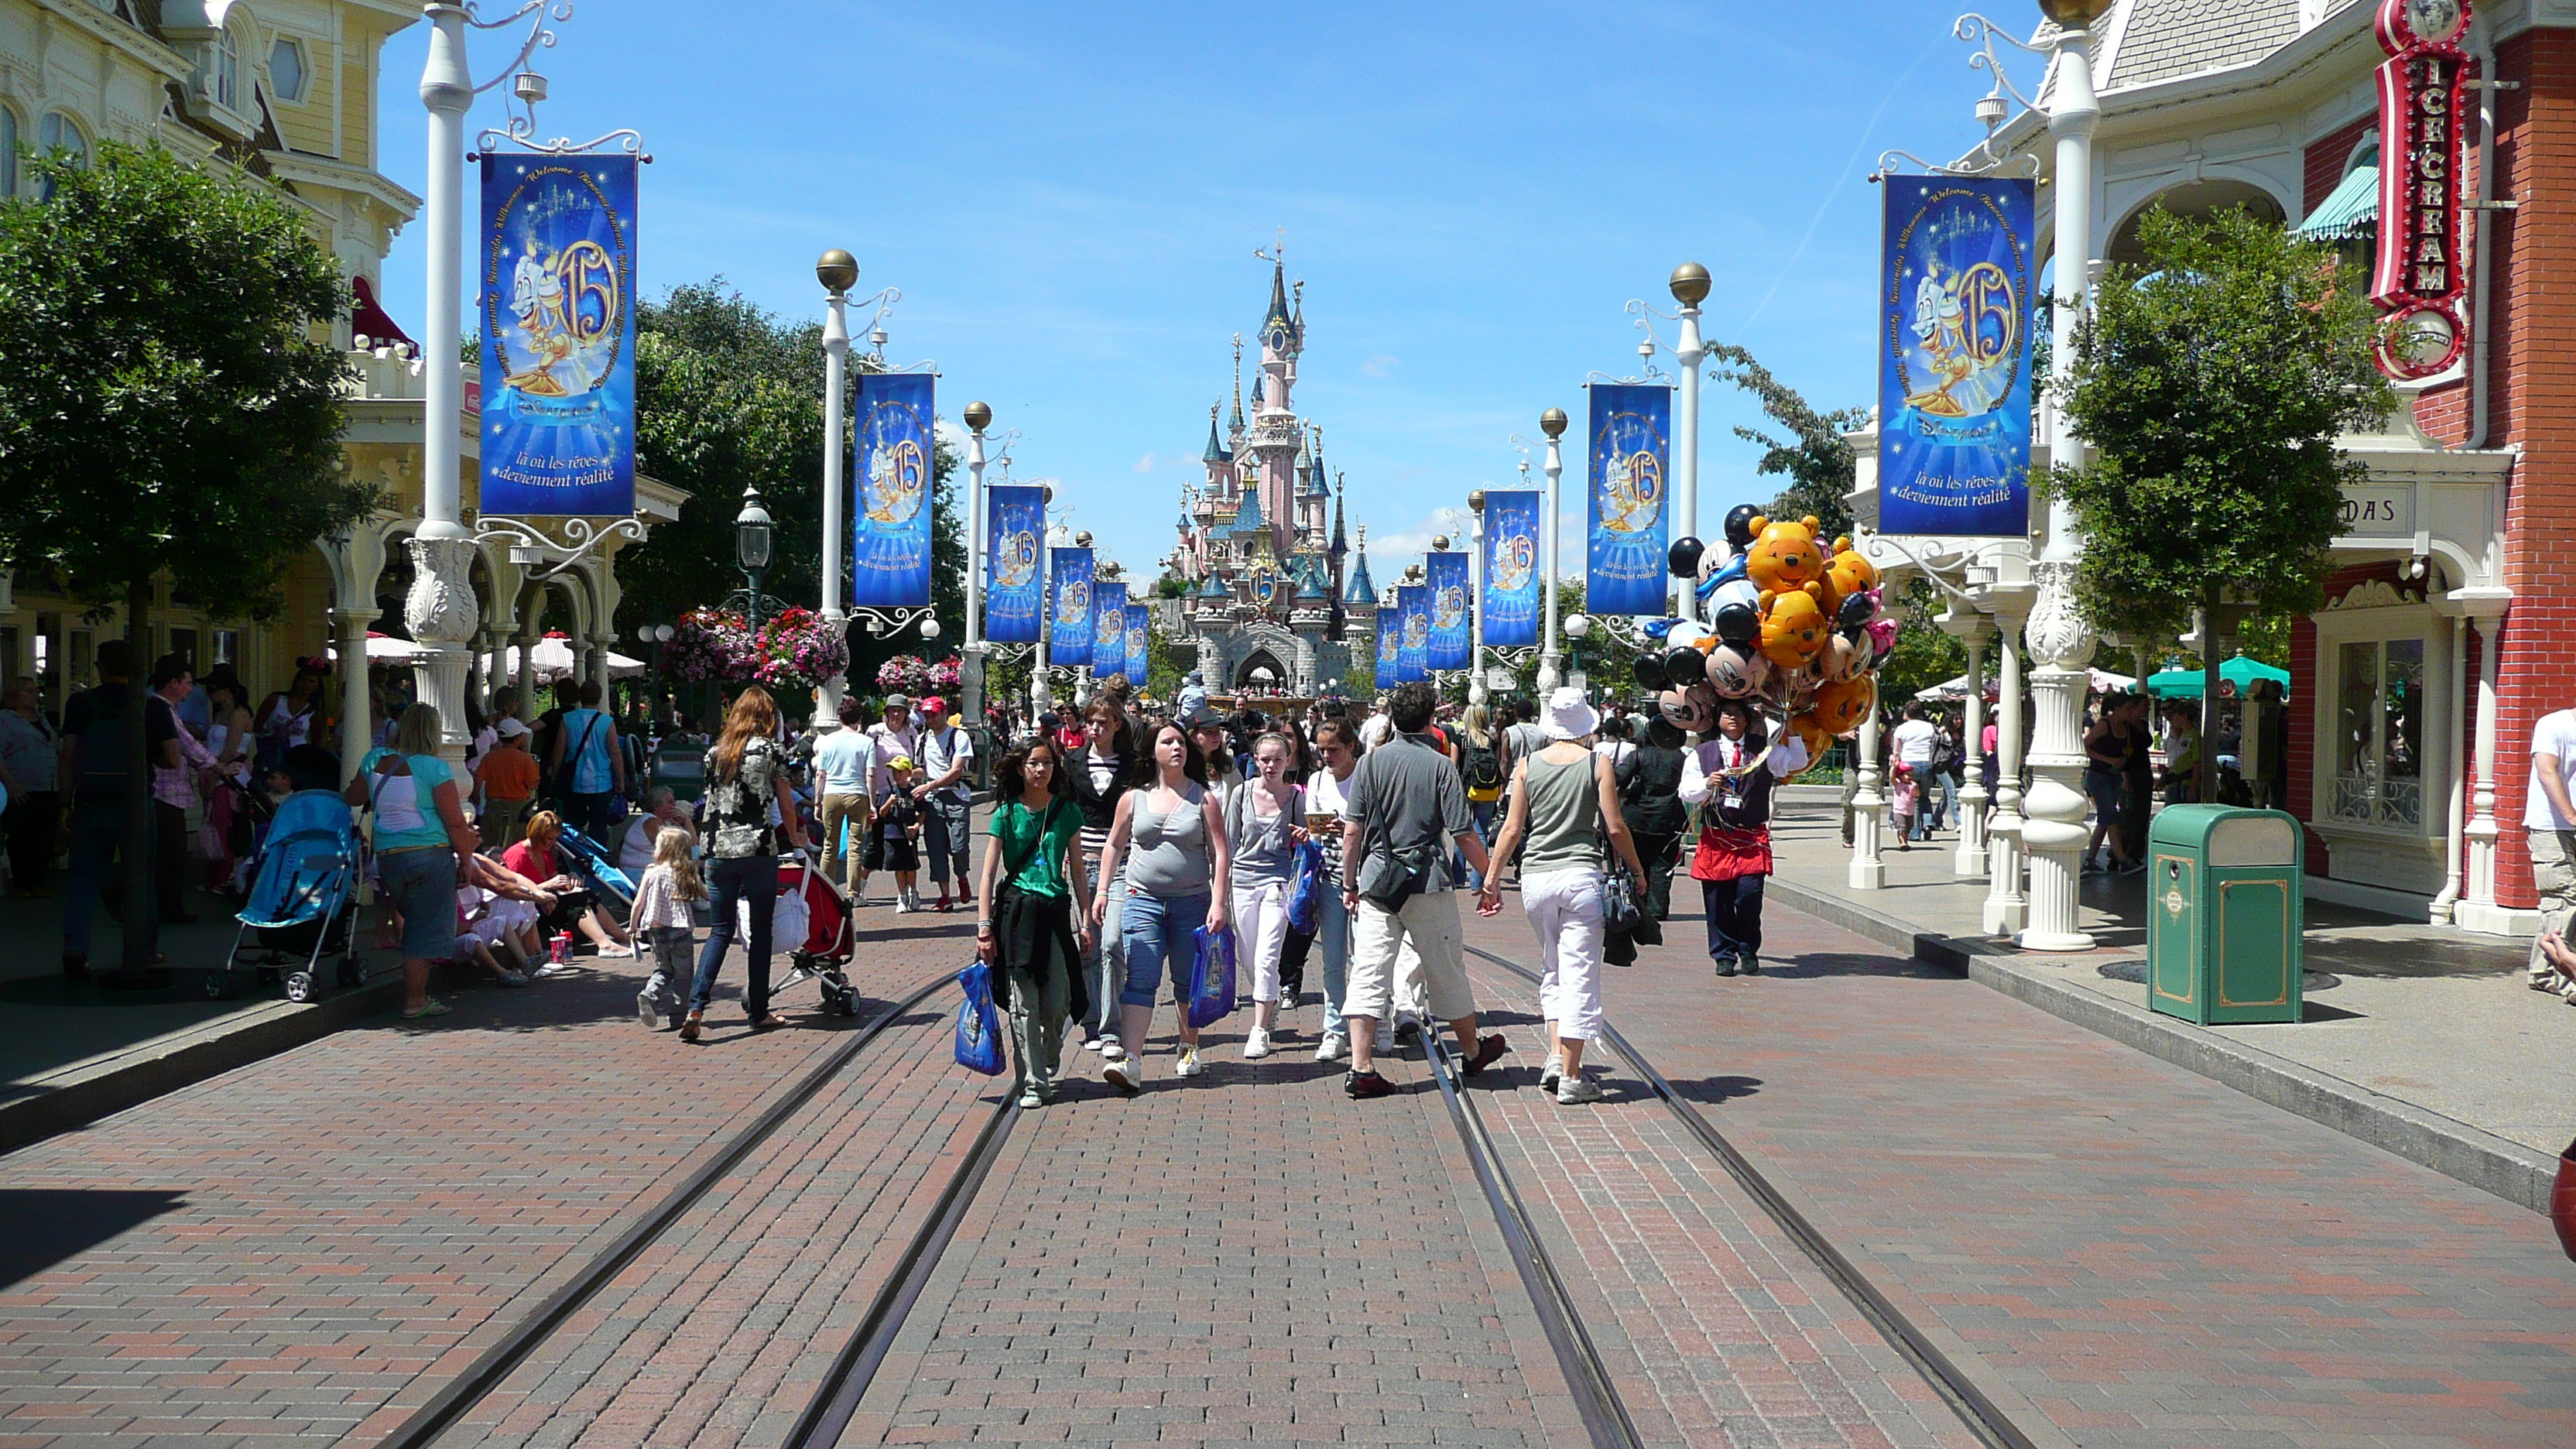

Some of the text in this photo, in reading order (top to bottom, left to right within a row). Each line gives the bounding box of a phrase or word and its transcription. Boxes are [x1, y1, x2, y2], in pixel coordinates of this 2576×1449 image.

[526, 166, 574, 182] Welcome
[2416, 60, 2446, 290] ICE CREAM
[1928, 187, 1975, 204] Welcome
[559, 241, 616, 341] 15
[1958, 263, 2016, 365] 15
[516, 451, 598, 469] là où les rêves
[893, 440, 923, 492] 15
[498, 466, 615, 488] deviennent réalité
[1629, 450, 1660, 503] 15
[1915, 471, 1995, 490] là où les rêves
[1898, 485, 2011, 507] deviennent réalité
[1015, 531, 1036, 566] 15
[1511, 535, 1533, 570] 15
[1073, 581, 1088, 608] 15
[1447, 586, 1464, 612] 15
[1109, 609, 1122, 632] 15
